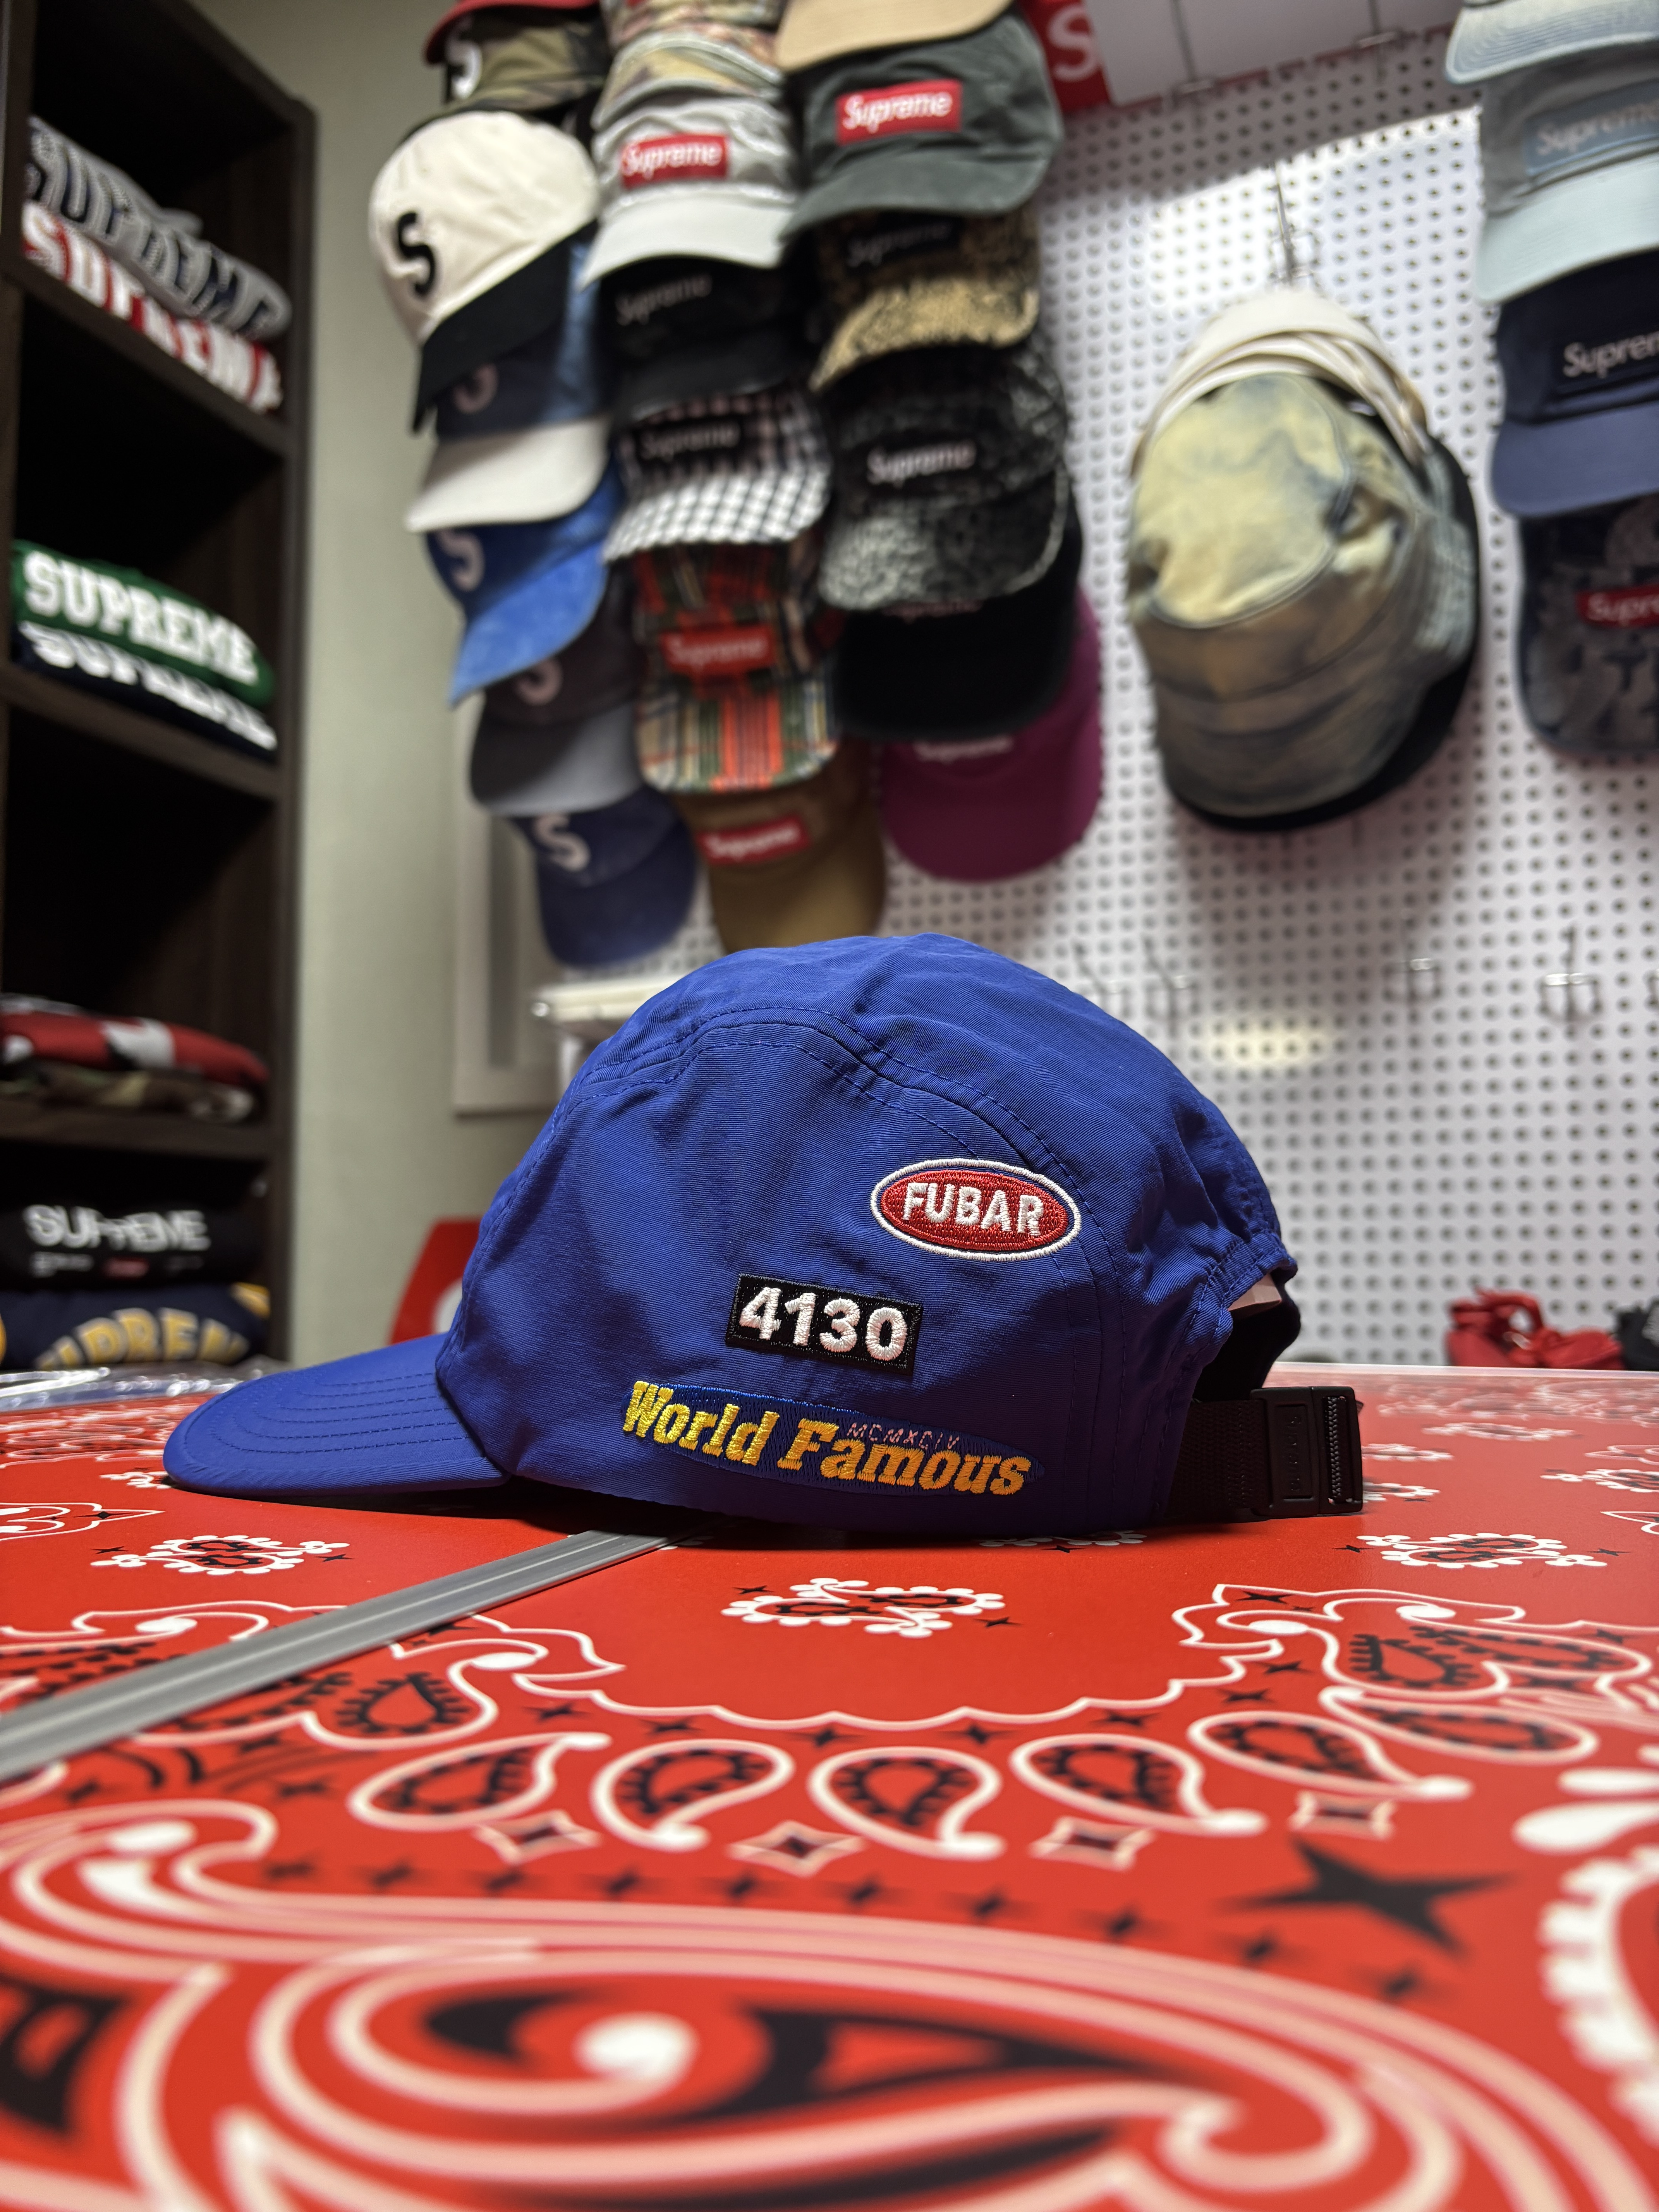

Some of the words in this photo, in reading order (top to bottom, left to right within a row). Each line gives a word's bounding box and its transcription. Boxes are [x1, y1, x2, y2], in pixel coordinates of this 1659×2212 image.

[841, 91, 954, 134] Supreme
[621, 141, 725, 180] Supreme
[397, 211, 436, 297] S
[867, 439, 977, 489] Supreme
[23, 549, 259, 687] SUPREME
[532, 811, 591, 872] S
[902, 1182, 1044, 1237] FUBAR
[739, 1286, 908, 1362] 4130
[622, 1380, 780, 1466] World
[777, 1417, 1032, 1496] Famous
[847, 1422, 960, 1450] MCMXCIV
